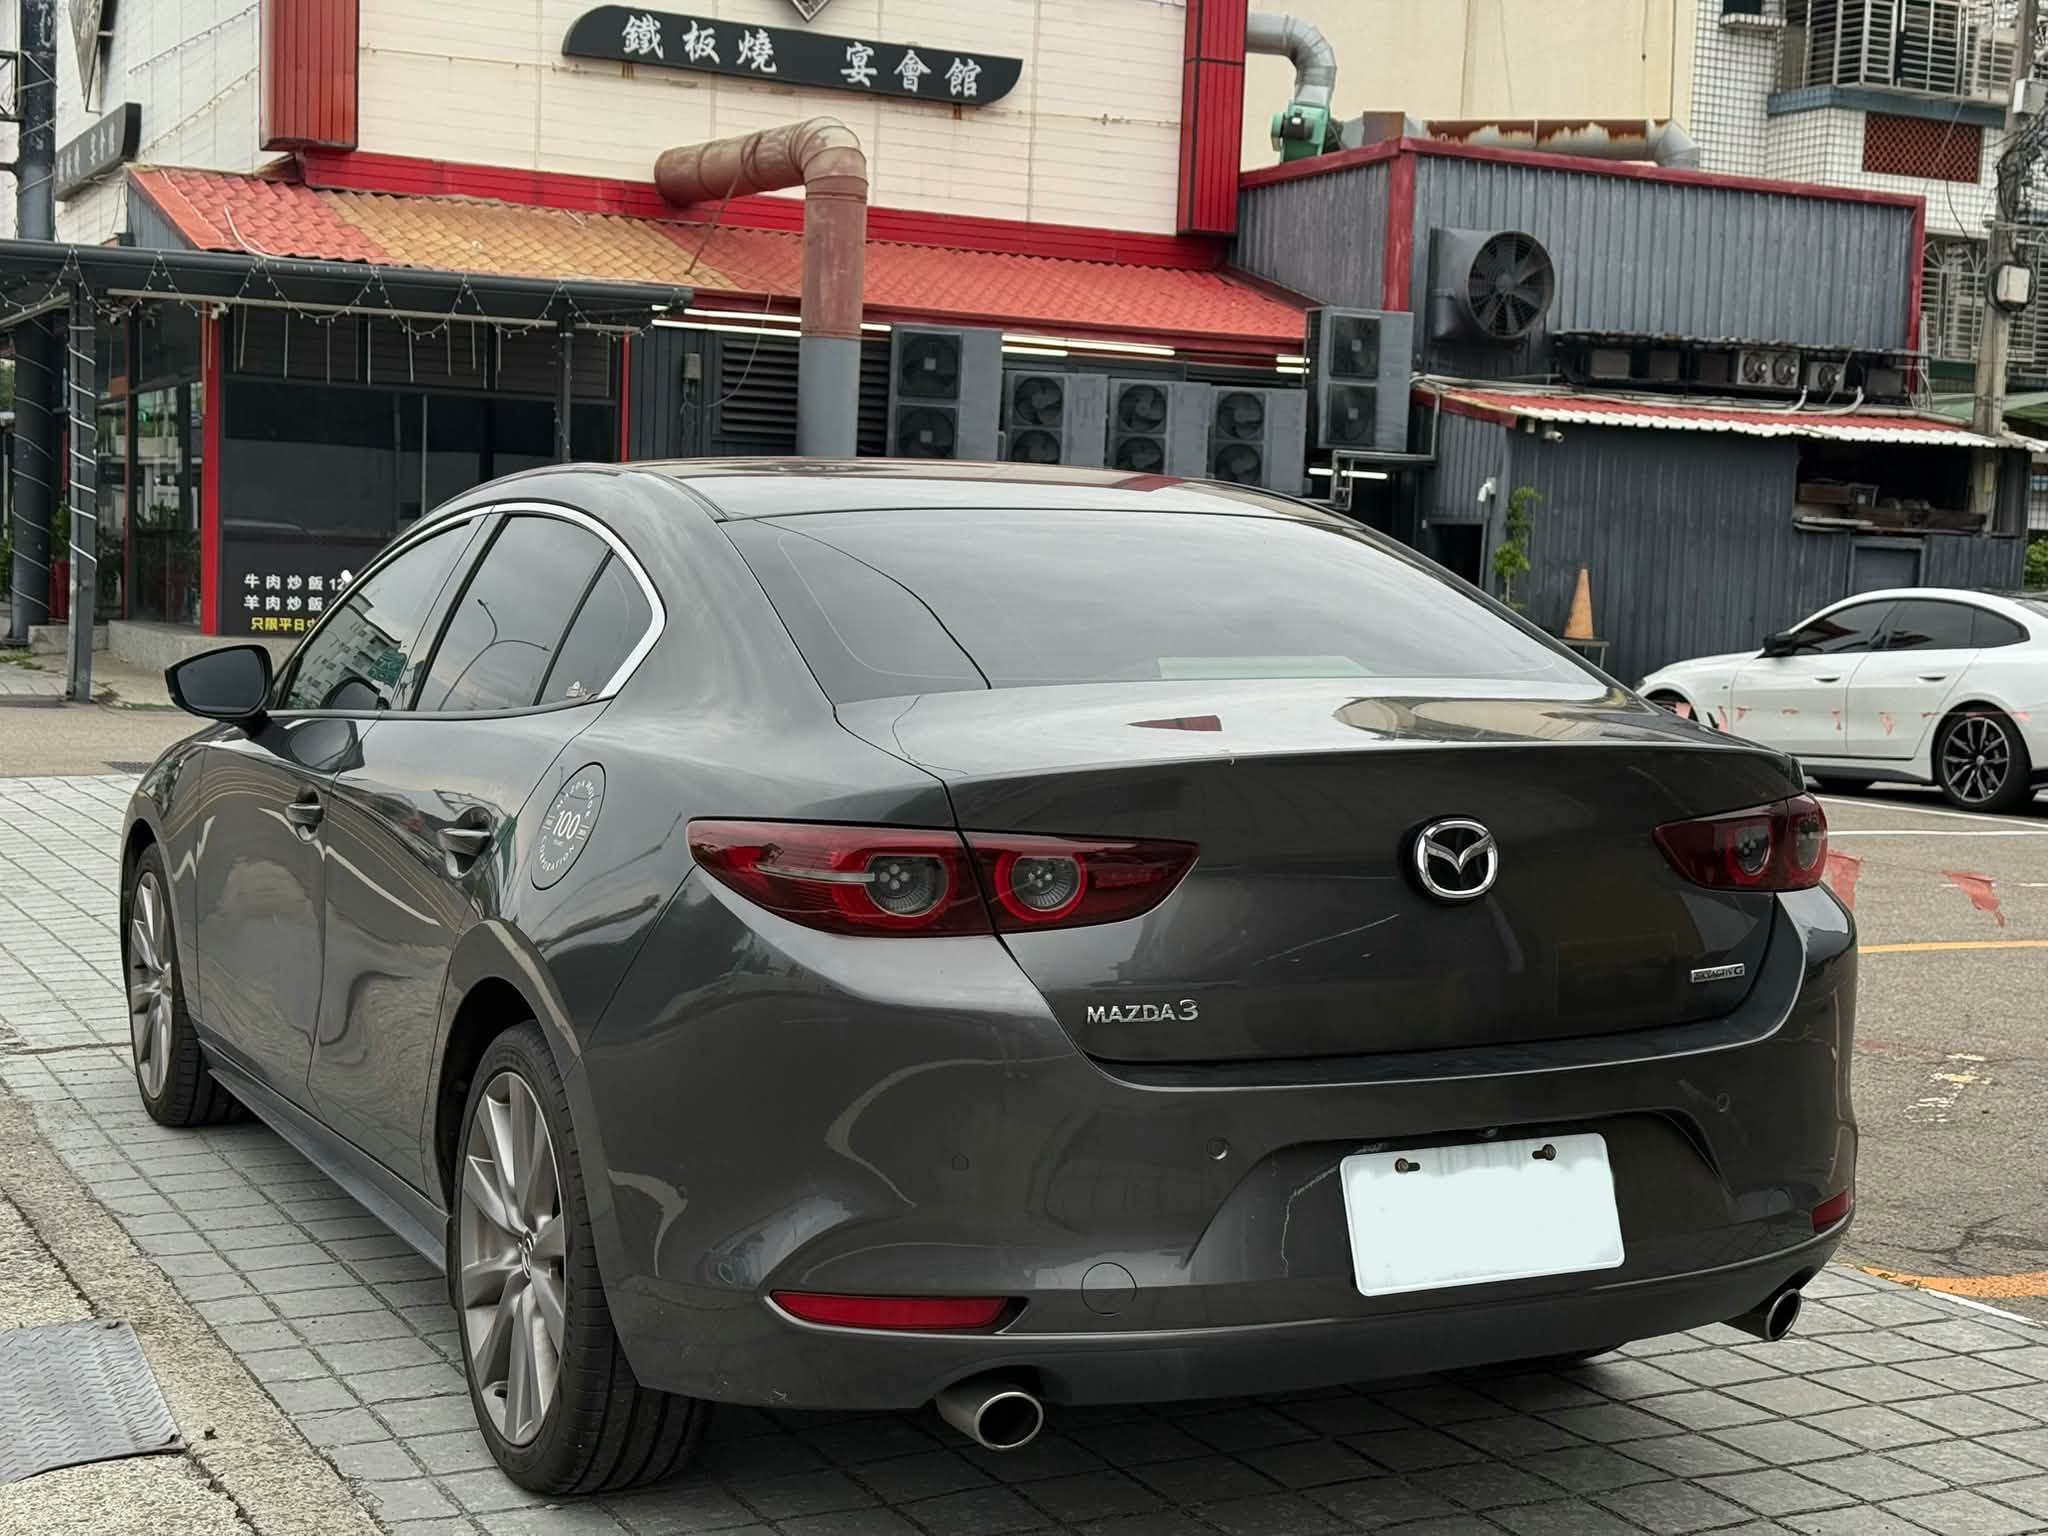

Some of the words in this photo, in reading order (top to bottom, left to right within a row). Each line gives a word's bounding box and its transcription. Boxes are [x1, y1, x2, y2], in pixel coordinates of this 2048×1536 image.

[622, 14, 777, 74] 鐵板燒
[840, 41, 982, 98] 宴會館
[244, 573, 323, 590] 牛肉炒飯
[243, 594, 323, 611] 羊肉炒飯
[552, 810, 581, 840] 100
